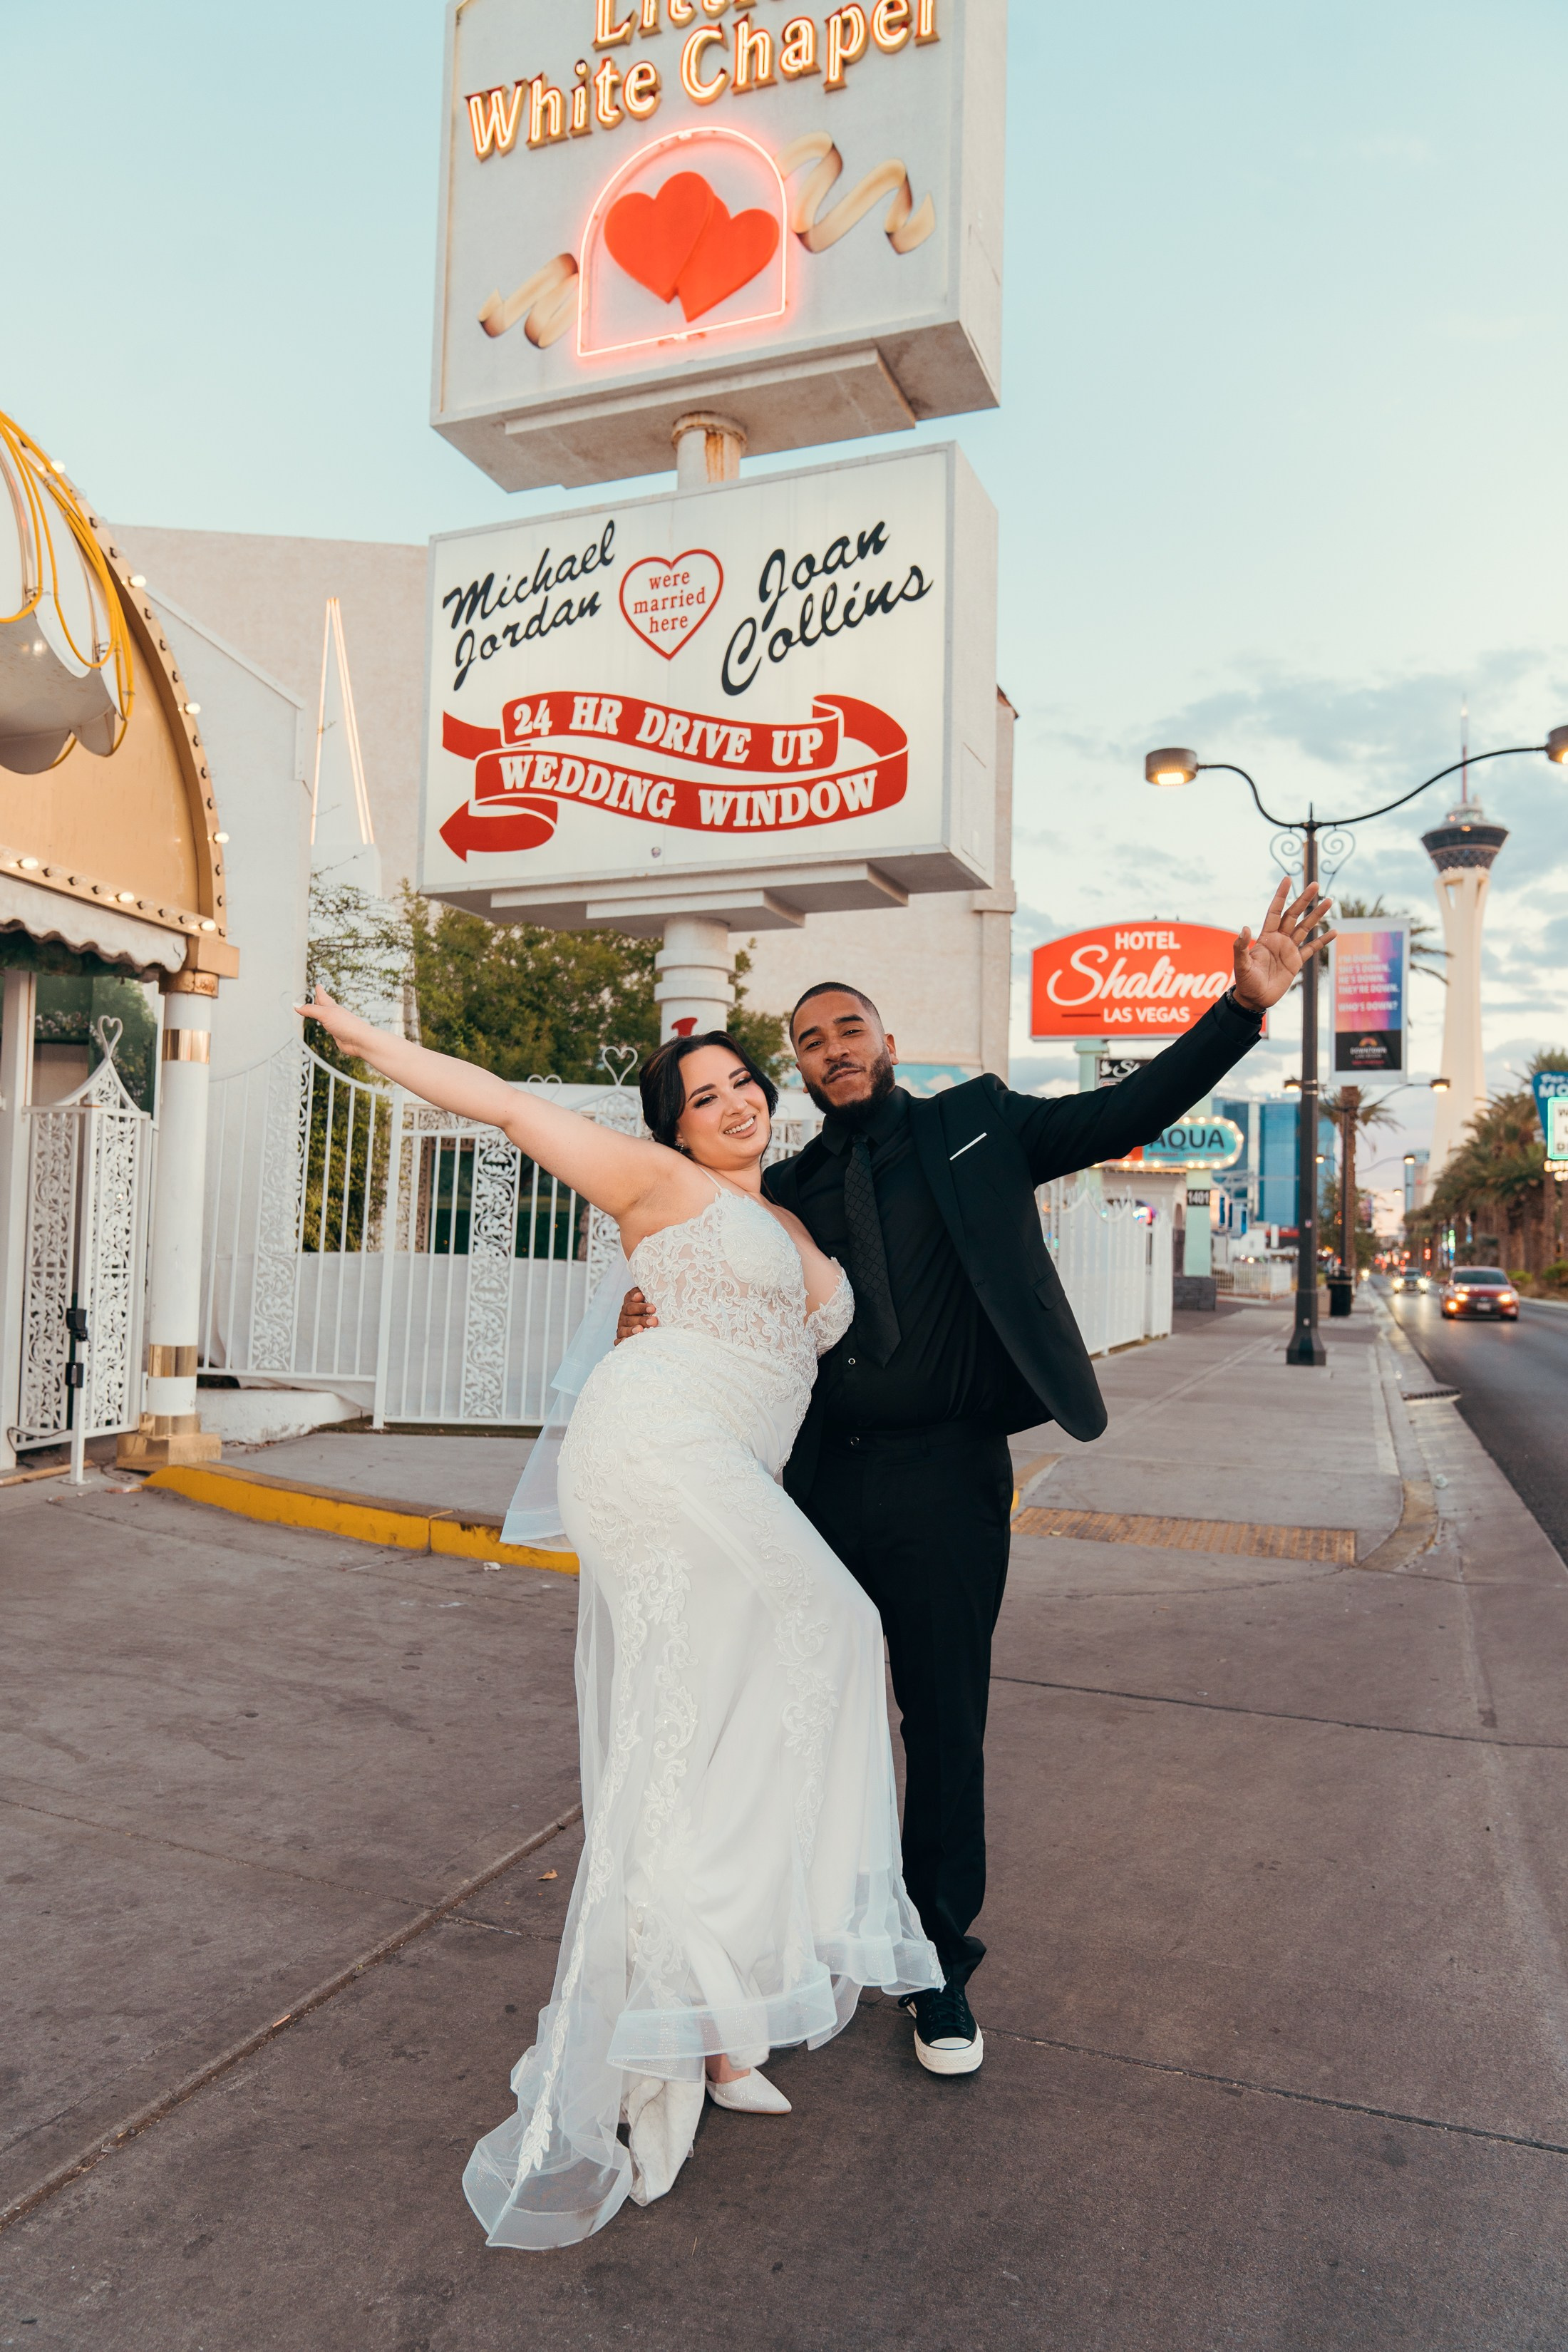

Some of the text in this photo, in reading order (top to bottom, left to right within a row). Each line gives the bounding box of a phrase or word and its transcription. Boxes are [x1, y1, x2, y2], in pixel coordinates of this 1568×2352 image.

[465, 57, 661, 162] White
[681, 0, 940, 105] Chapel
[443, 520, 616, 629] Michael
[649, 571, 691, 589] were
[758, 520, 891, 629] Joan
[634, 587, 706, 614] married
[648, 613, 688, 634] here
[721, 565, 933, 696] Collins
[453, 591, 602, 691] Jordan
[513, 696, 823, 766] 24 HR DRIVE UP
[499, 755, 878, 827] WEDDING WINDOW
[1115, 931, 1182, 950] HOTEL
[1103, 1006, 1190, 1023] LAS VEGAS
[1366, 1000, 1398, 1011] DOWN?
[1149, 1128, 1224, 1152] AQUA
[1188, 1190, 1209, 1205] 1401
